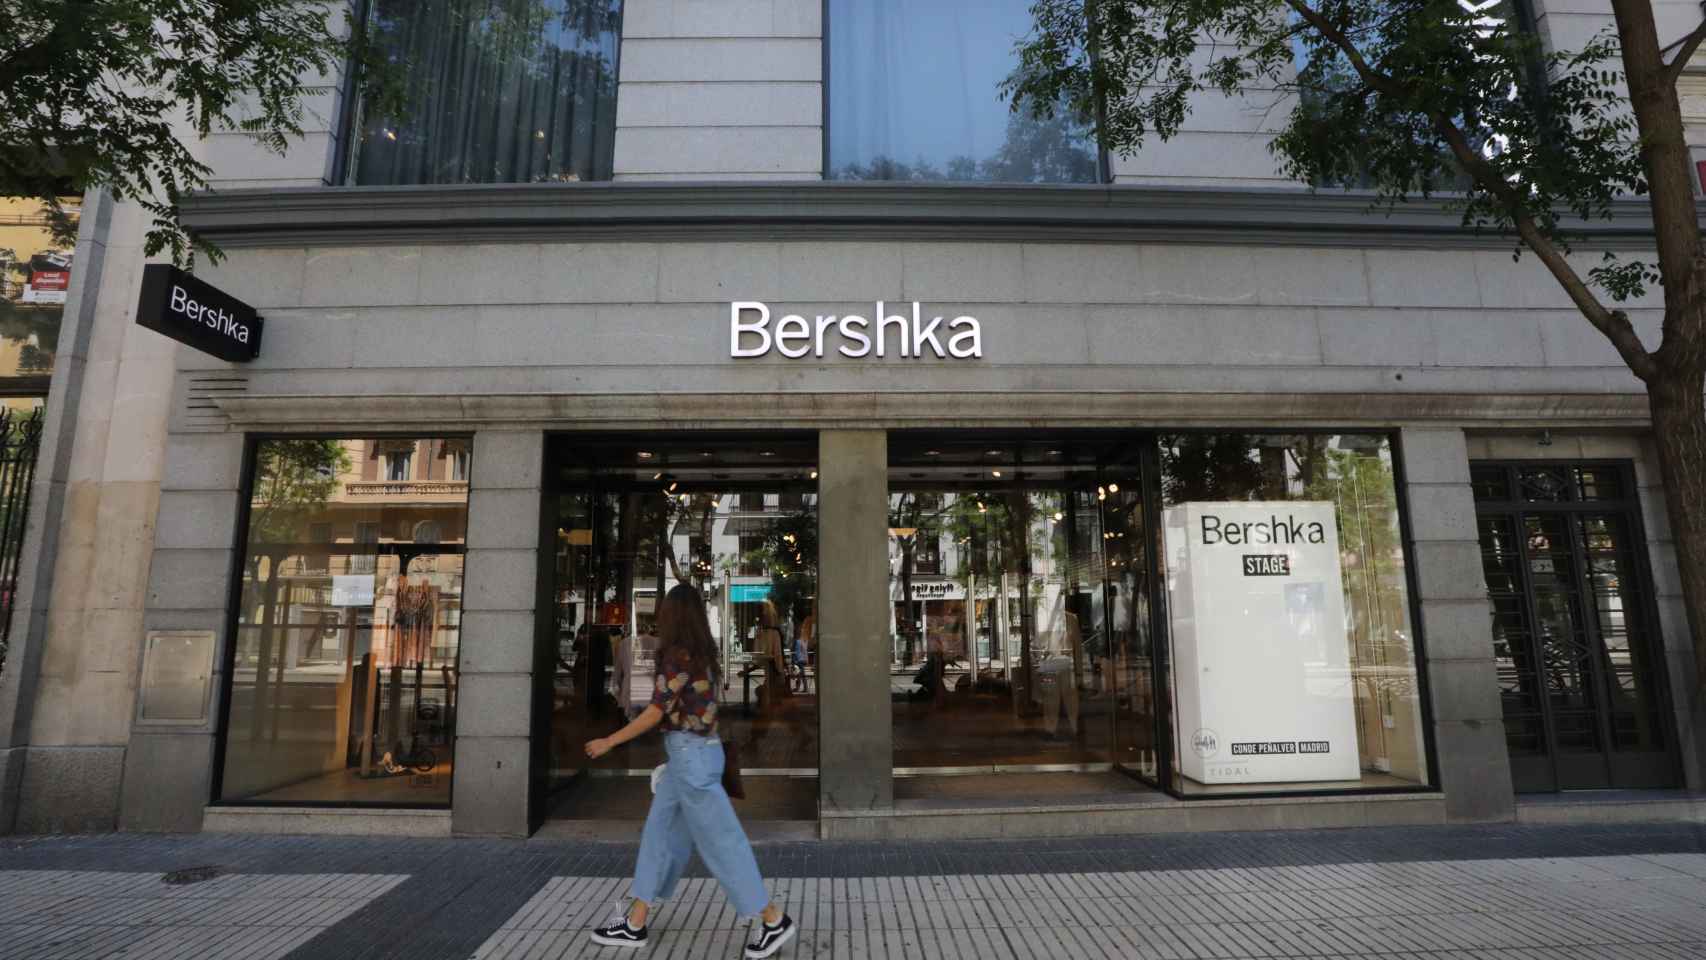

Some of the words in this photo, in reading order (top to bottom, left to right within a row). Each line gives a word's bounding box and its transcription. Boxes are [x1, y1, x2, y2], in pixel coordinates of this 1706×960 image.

[170, 285, 249, 344] Bershka
[730, 300, 983, 359] Bershka
[1201, 515, 1326, 545] Bershka
[1247, 557, 1286, 573] STAGE
[1233, 743, 1257, 754] CONDE
[1258, 741, 1296, 753] PEÑALVER
[1300, 742, 1328, 753] MADRID
